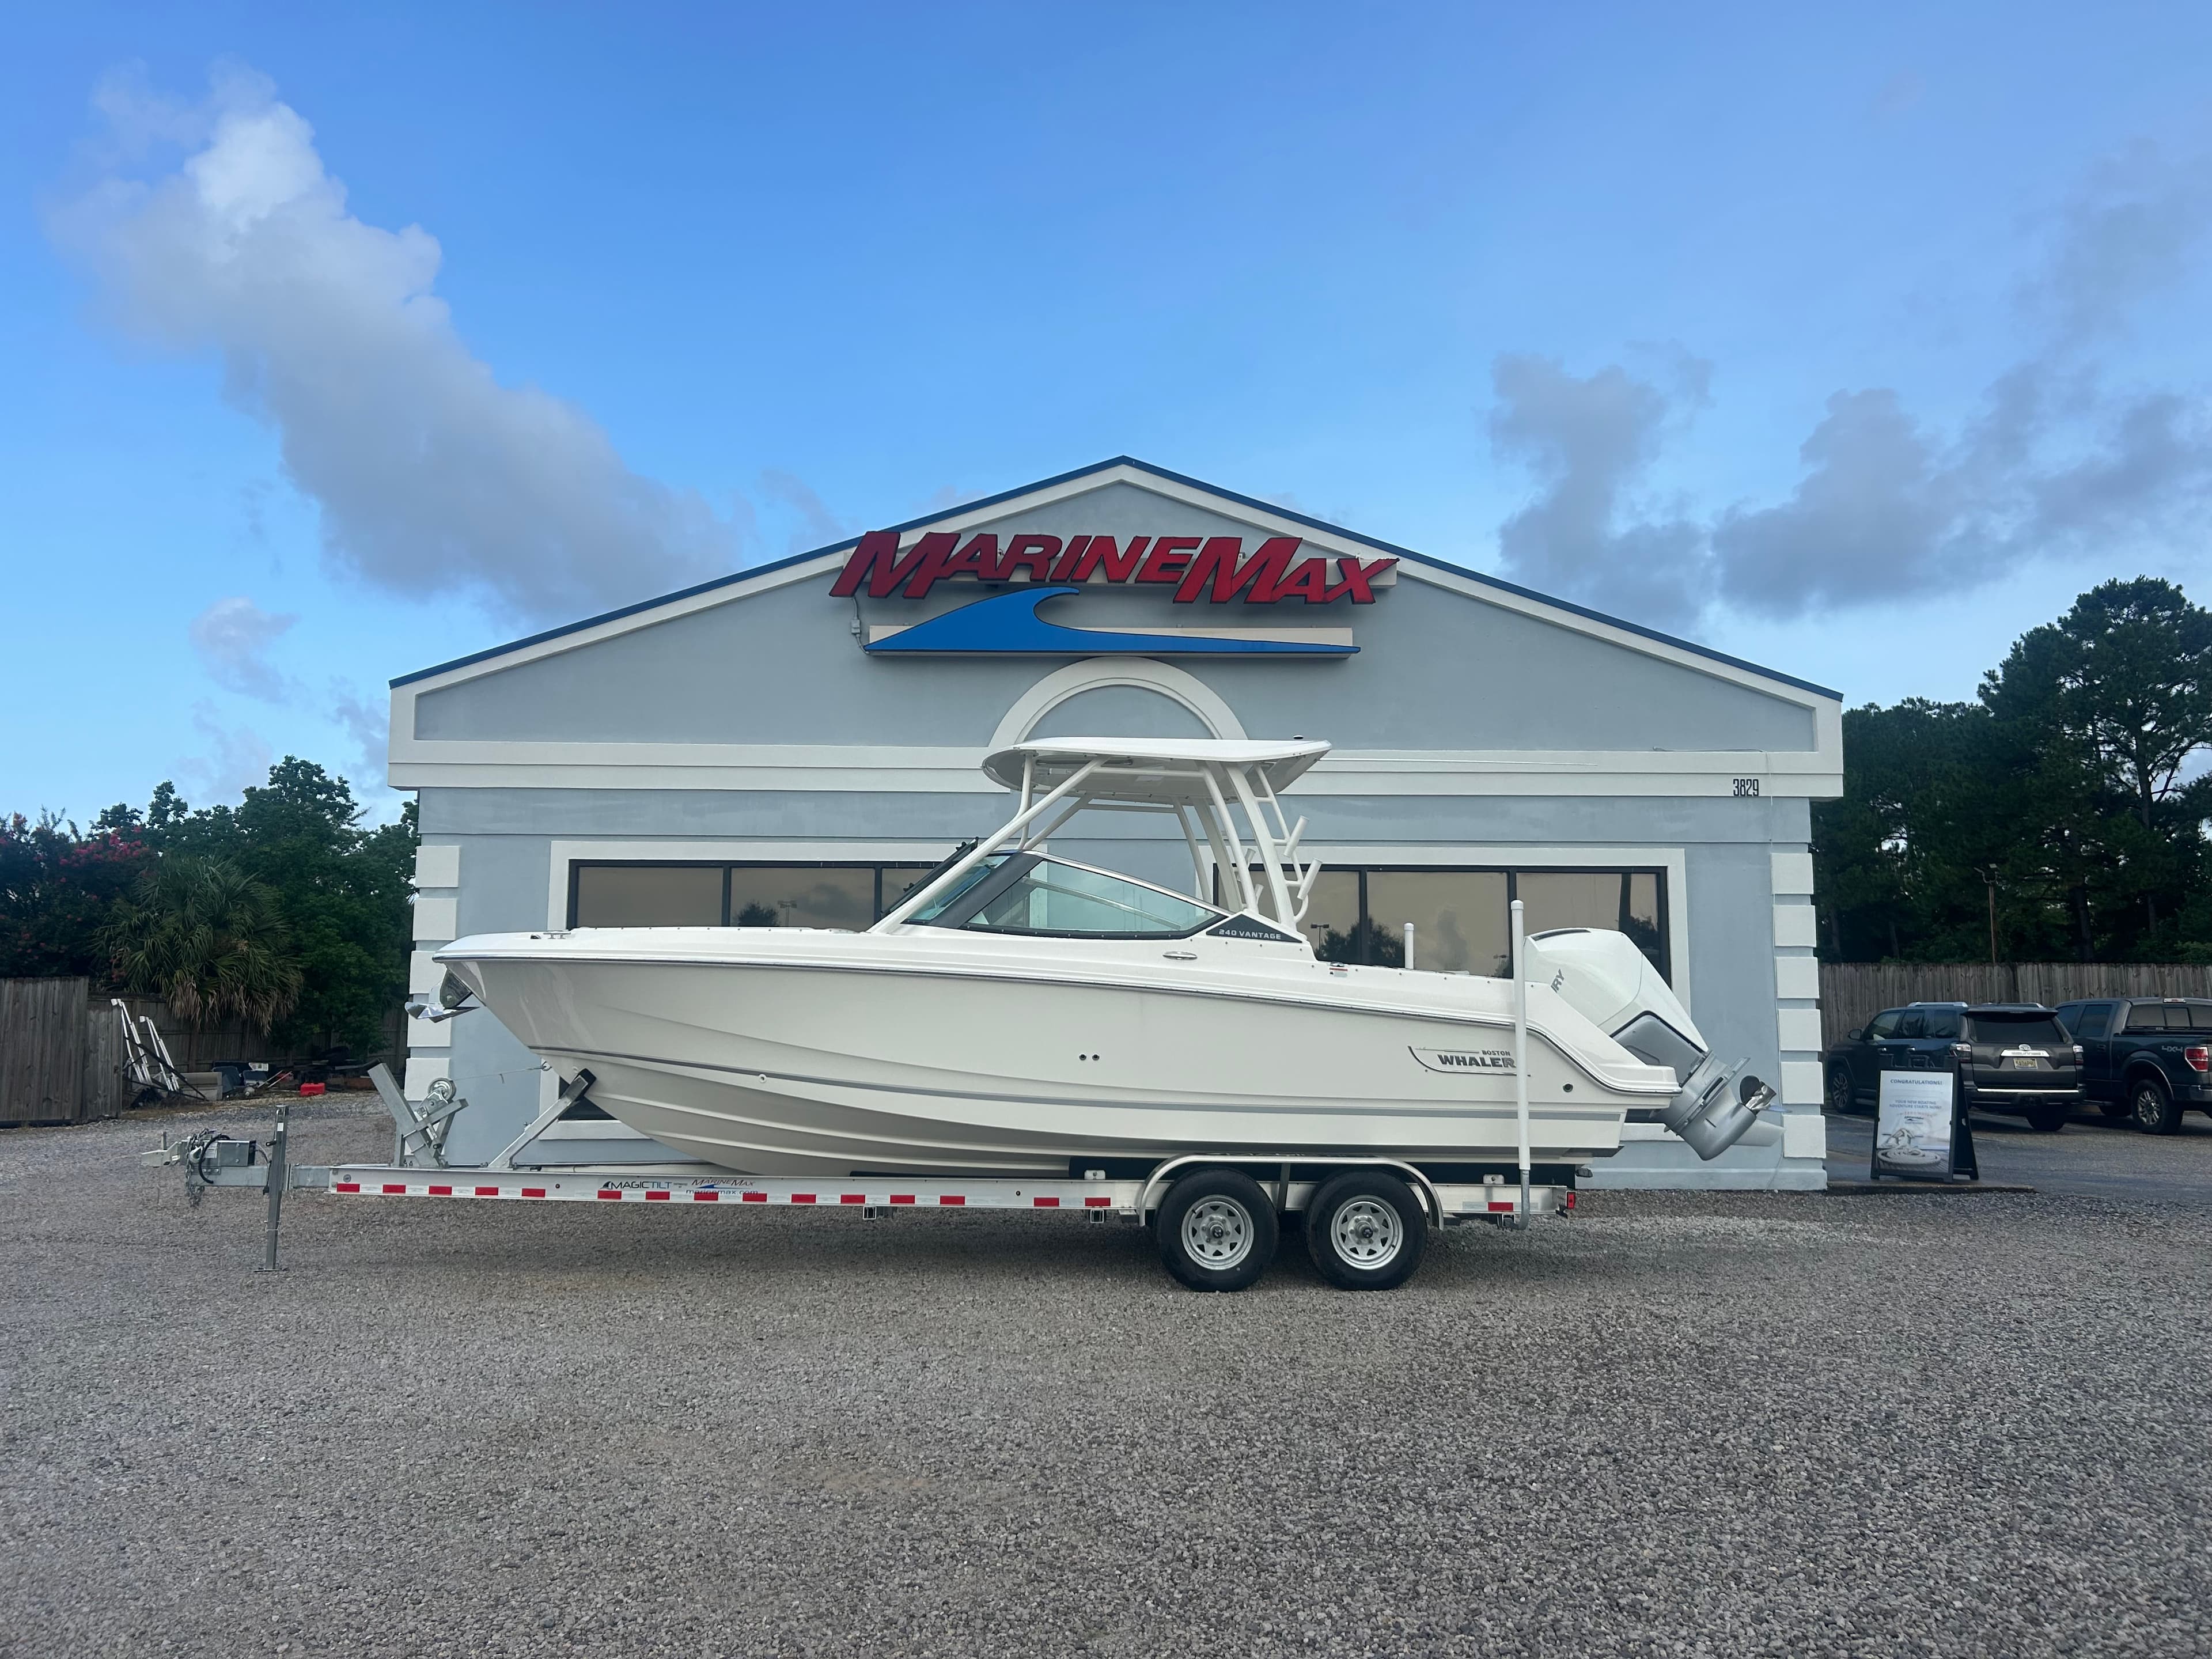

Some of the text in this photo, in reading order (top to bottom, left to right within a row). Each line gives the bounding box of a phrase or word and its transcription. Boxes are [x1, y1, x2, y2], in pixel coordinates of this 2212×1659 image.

[828, 531, 1400, 605] MARINEMAX
[1733, 778, 1759, 797] 3829
[1239, 930, 1281, 940] VANTAGE
[1550, 968, 1565, 994] RY
[1437, 1054, 1517, 1068] WHALER
[611, 1181, 672, 1190] MAGICTILT
